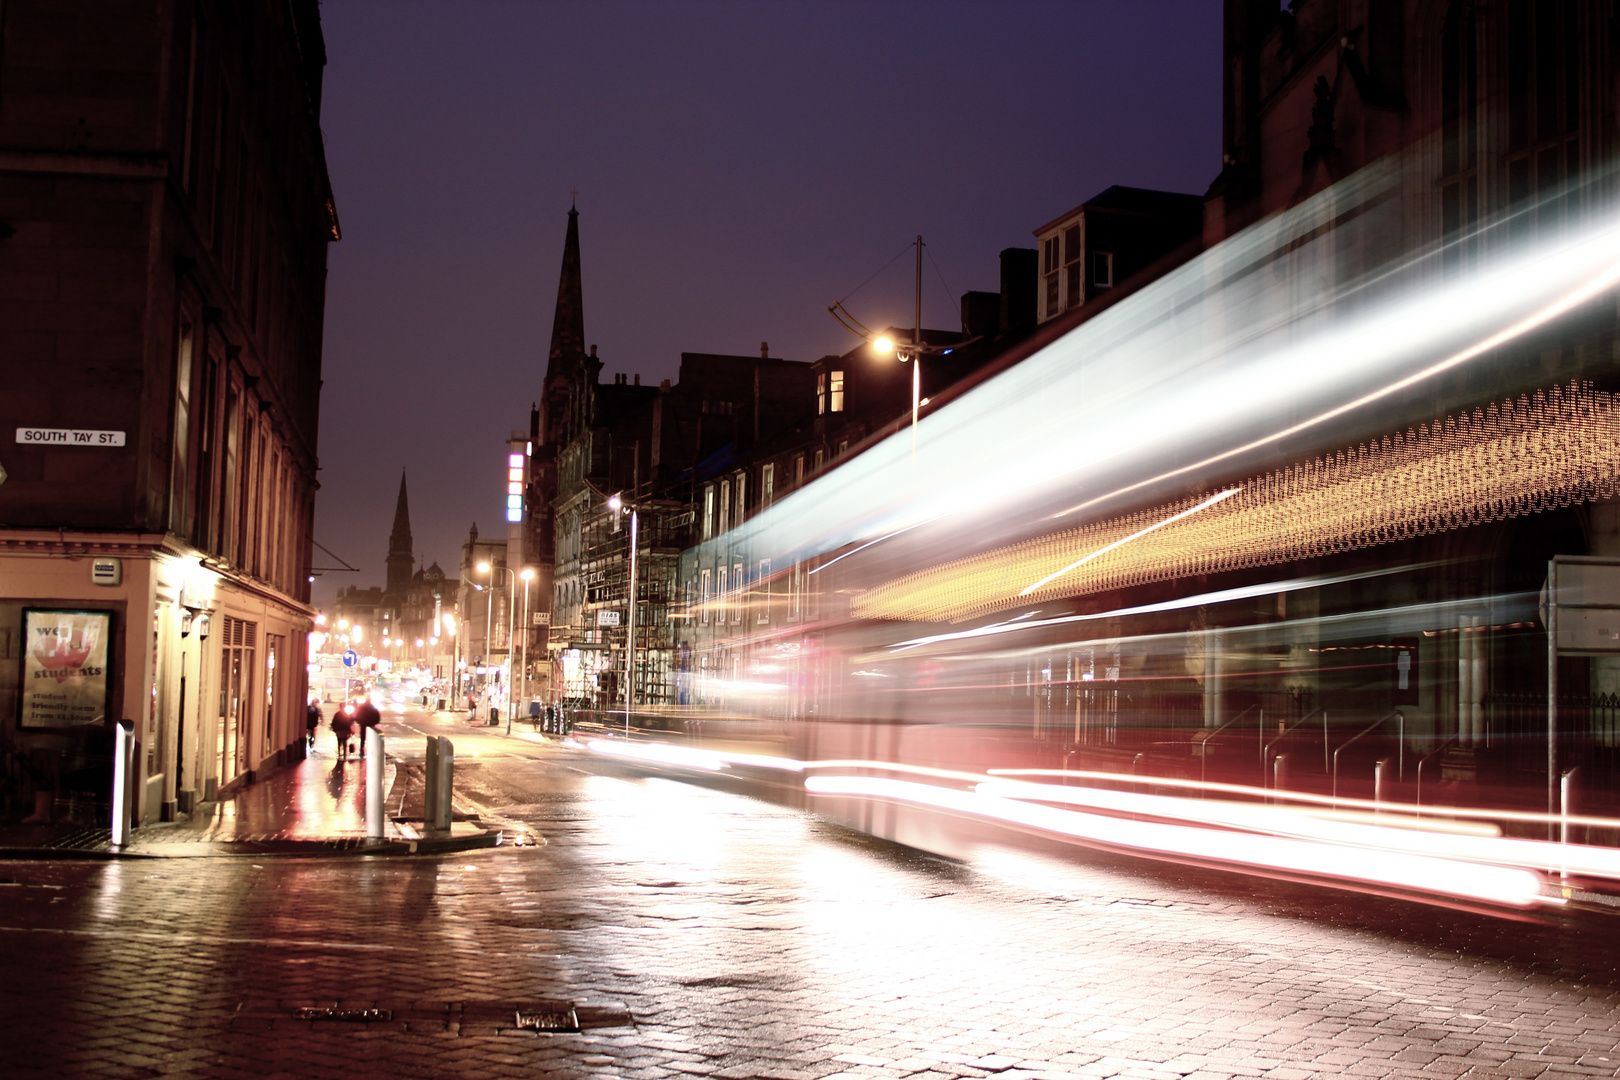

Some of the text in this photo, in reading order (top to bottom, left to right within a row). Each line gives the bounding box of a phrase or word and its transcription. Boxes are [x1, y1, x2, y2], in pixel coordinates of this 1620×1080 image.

[24, 430, 118, 444] SOUTH TAY ST.
[36, 626, 60, 636] we
[34, 665, 102, 679] students
[32, 702, 68, 711] friendly
[31, 711, 54, 719] from
